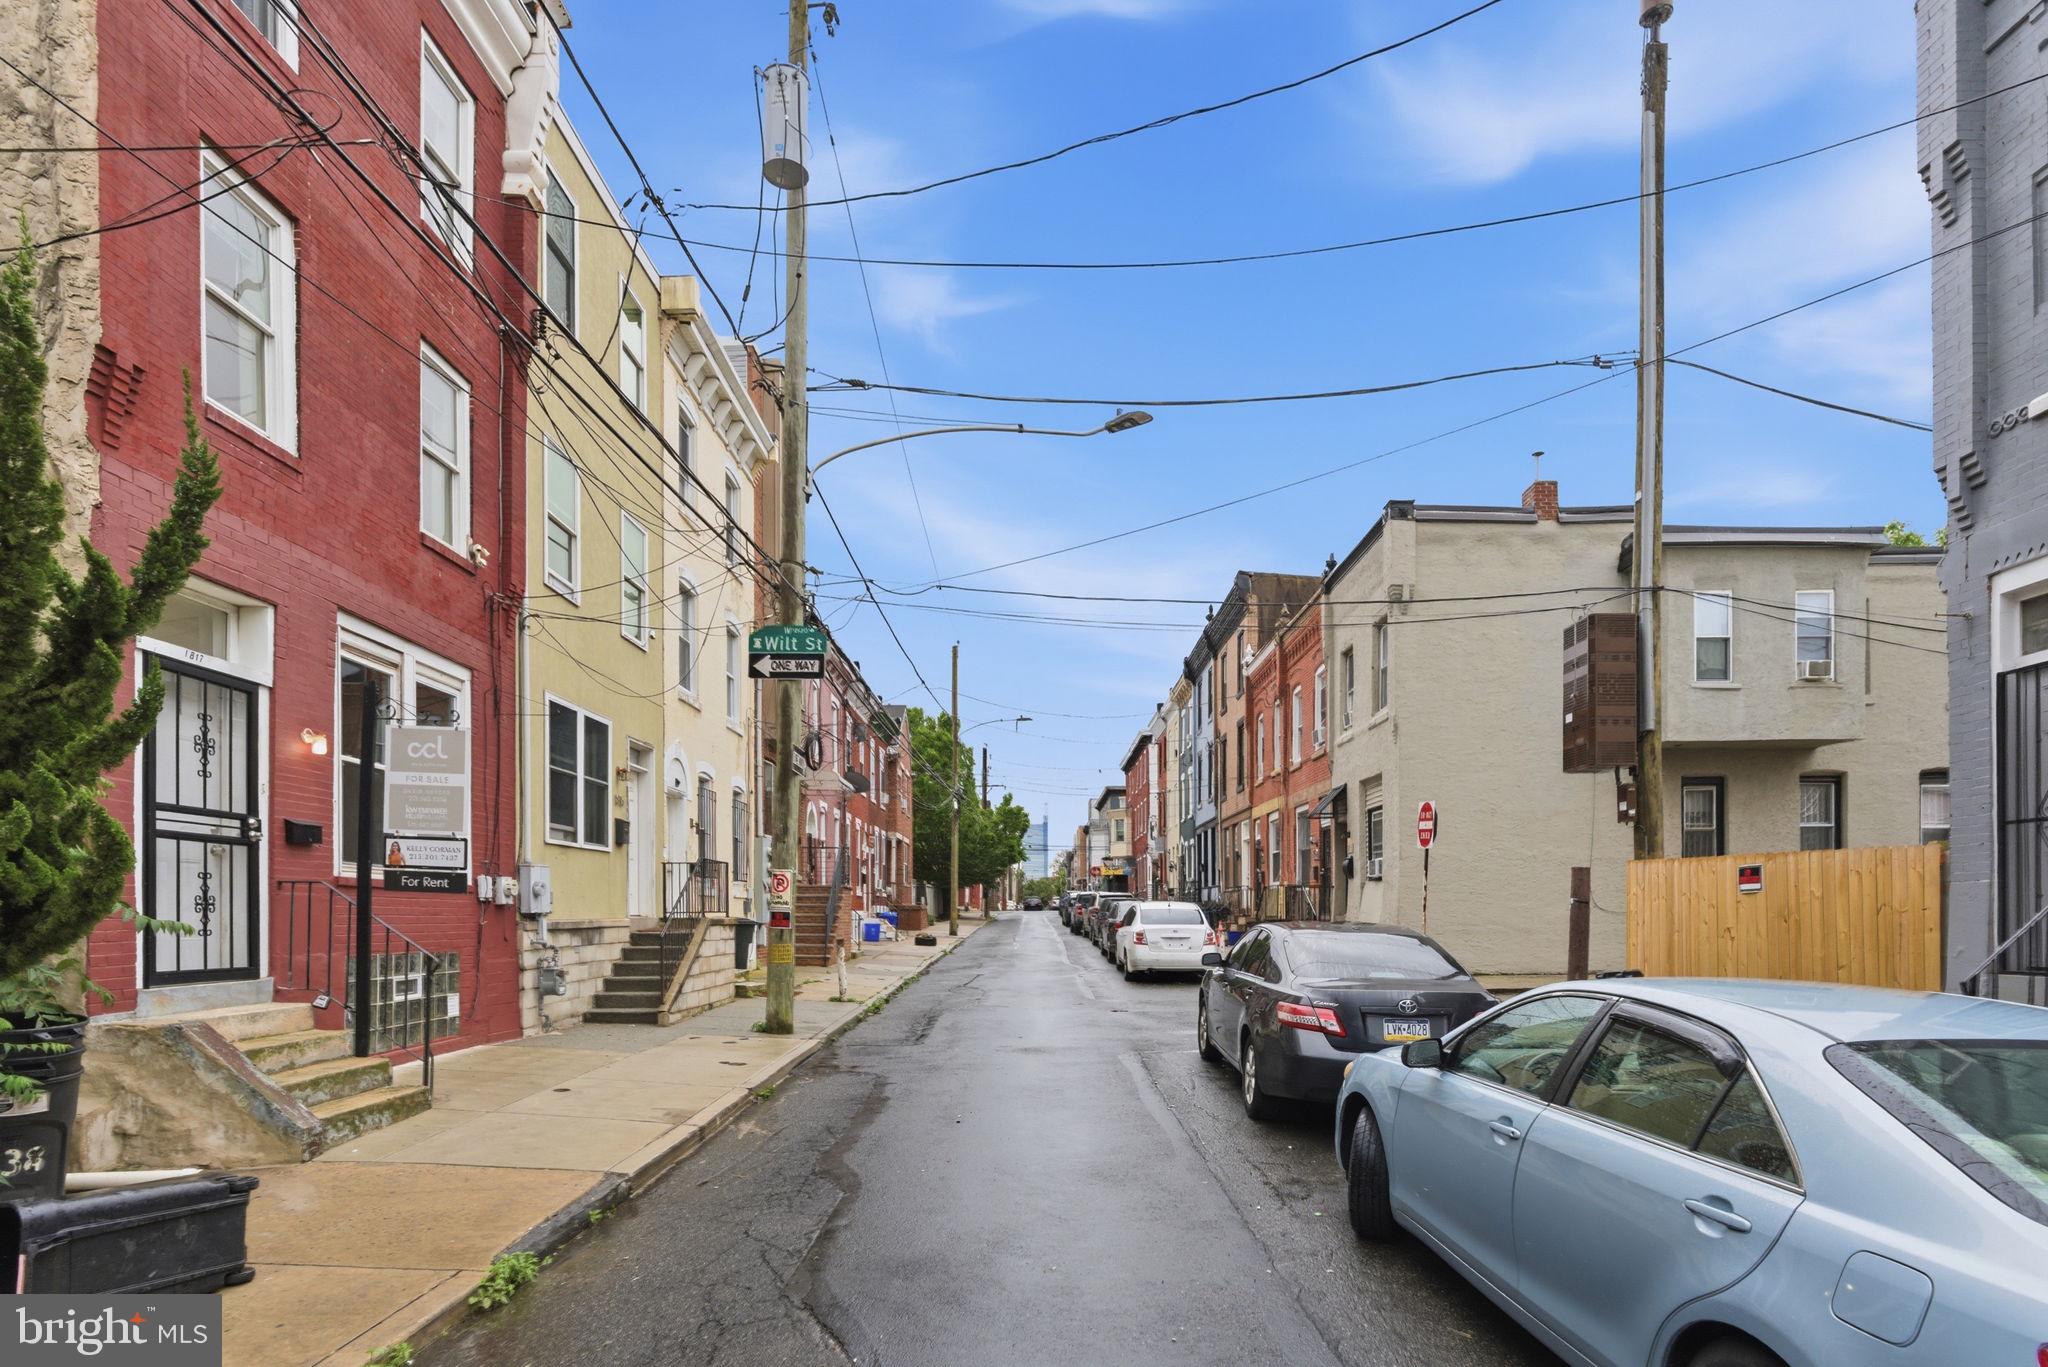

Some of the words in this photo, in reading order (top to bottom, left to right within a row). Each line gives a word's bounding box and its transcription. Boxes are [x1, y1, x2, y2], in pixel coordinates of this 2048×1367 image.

[764, 636, 798, 651] Wilt
[805, 637, 823, 651] St
[184, 650, 204, 662] 1817
[771, 660, 792, 671] ONE
[794, 660, 816, 671] WAY
[405, 775, 424, 783] FOR
[426, 775, 449, 784] SALE
[401, 876, 420, 887] For
[423, 876, 450, 888] Rent
